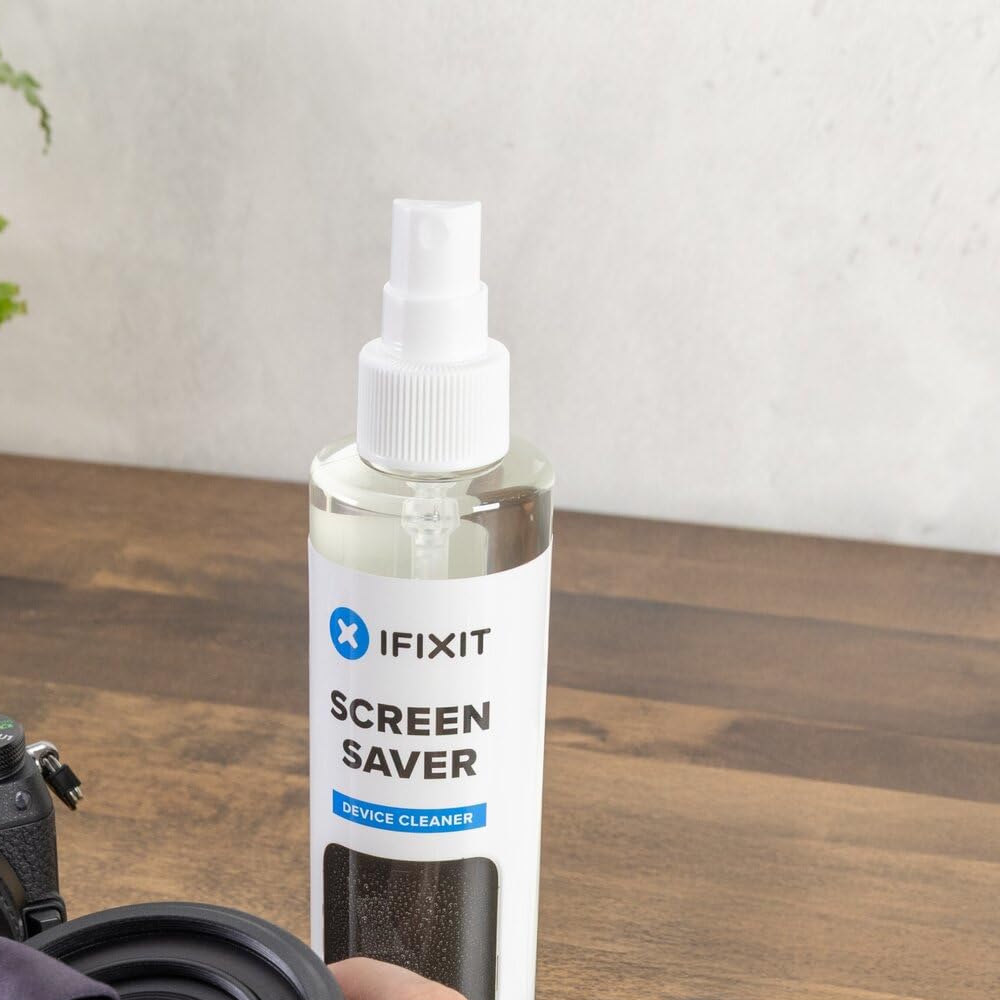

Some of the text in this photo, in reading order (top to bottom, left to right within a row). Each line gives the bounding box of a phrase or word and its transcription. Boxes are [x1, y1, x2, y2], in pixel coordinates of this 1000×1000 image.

[380, 627, 492, 659] IFIXIT
[330, 689, 491, 736] SCREEN
[342, 738, 477, 780] SAVER
[342, 801, 473, 828] DEVICE CLEANER
